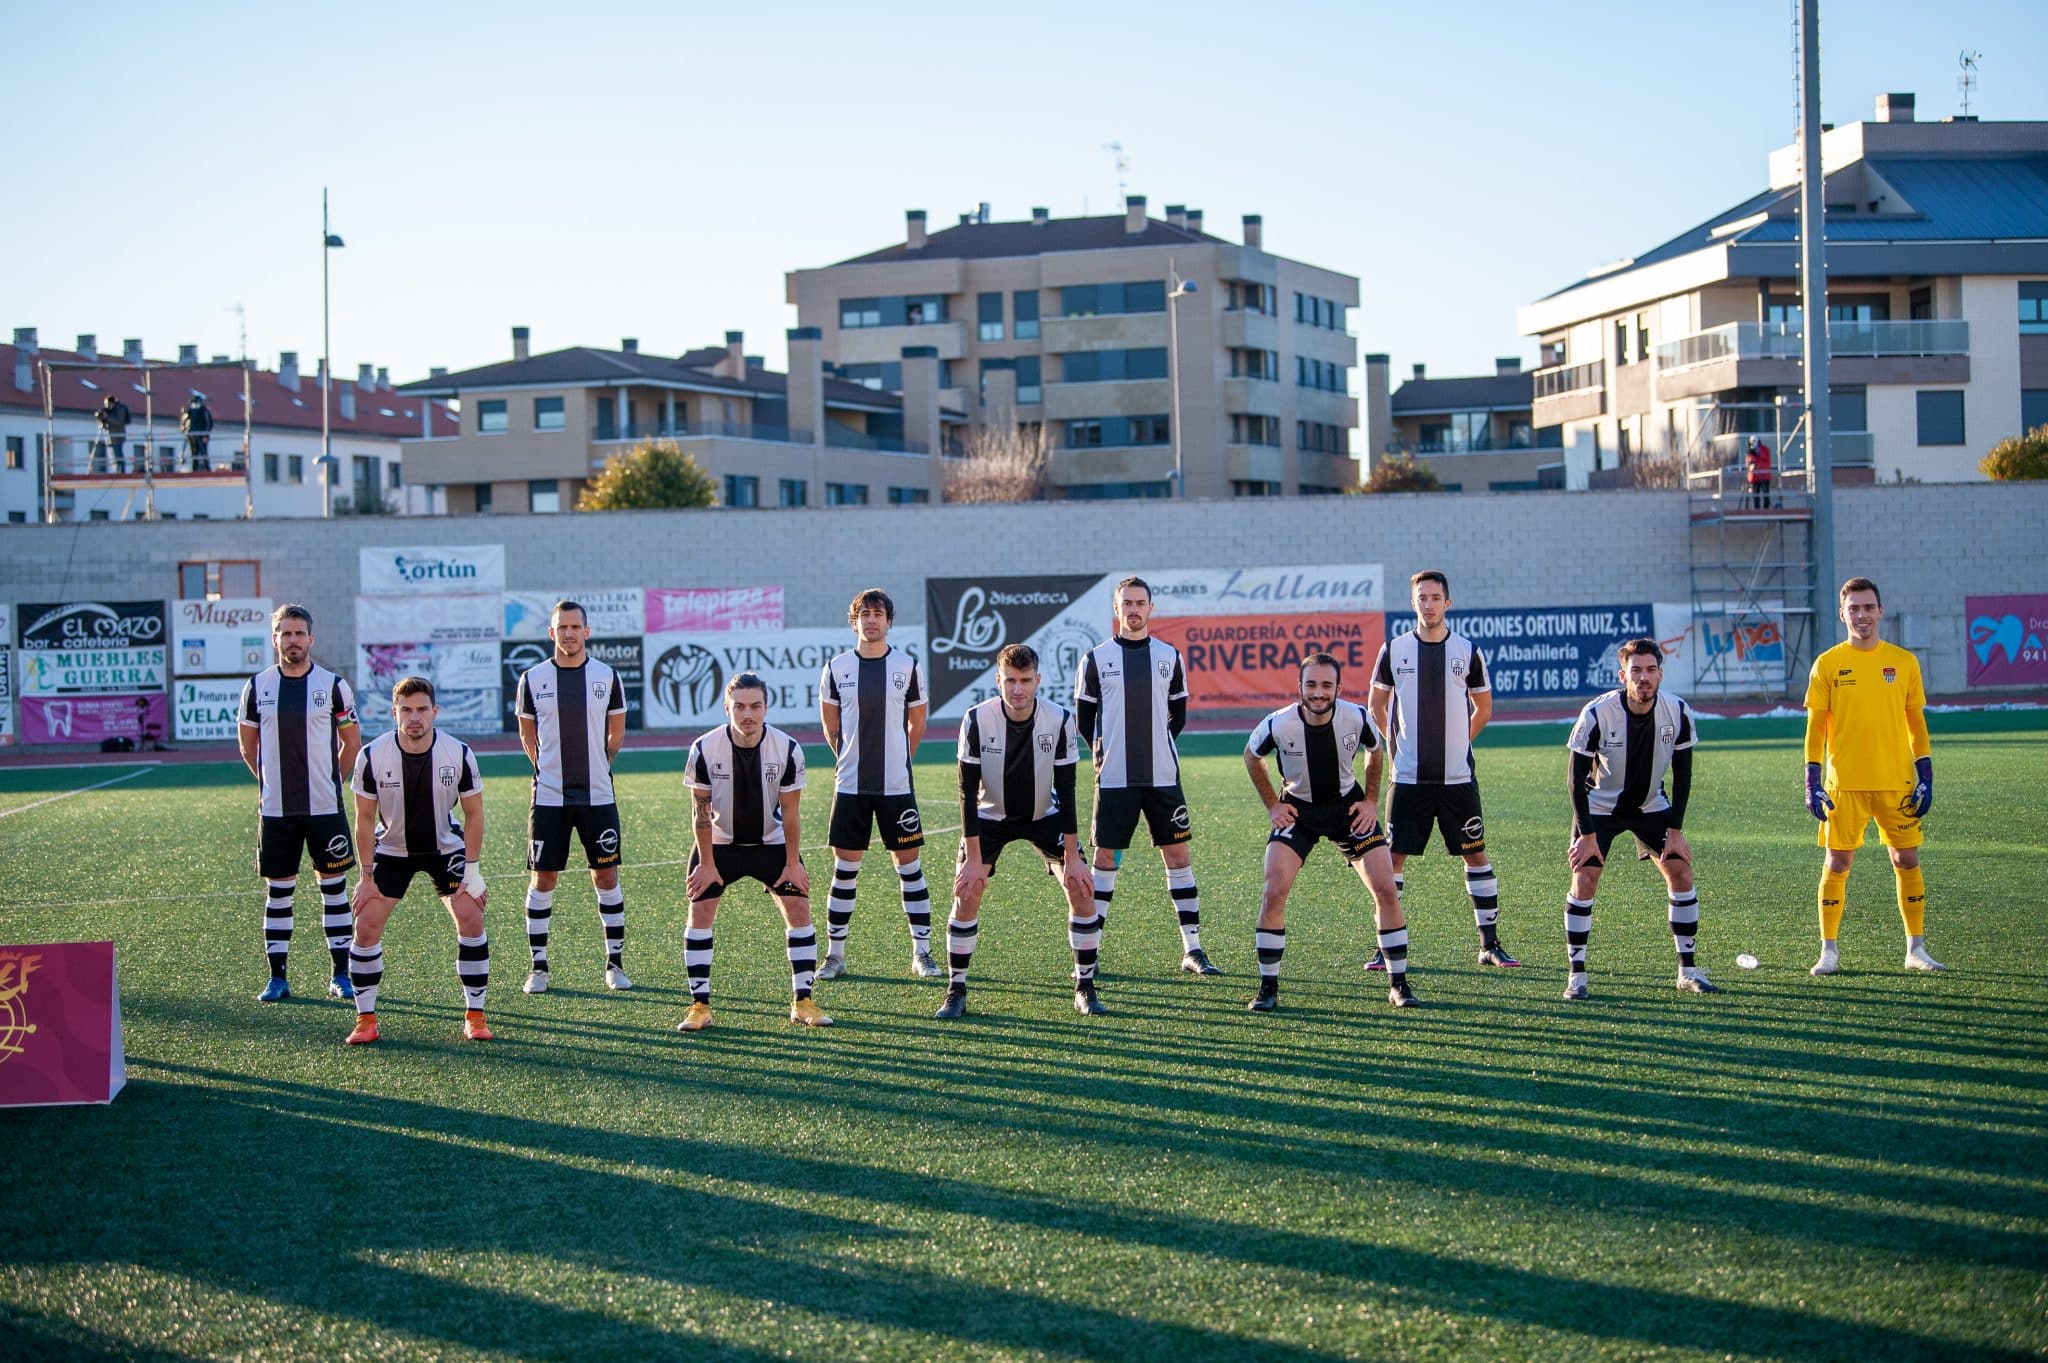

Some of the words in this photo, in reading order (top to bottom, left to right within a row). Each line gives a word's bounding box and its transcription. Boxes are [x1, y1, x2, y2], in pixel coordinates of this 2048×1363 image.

[1151, 585, 1208, 597] OCARES
[1217, 569, 1374, 602] Lallana
[183, 603, 264, 629] Muga
[1525, 614, 1577, 636] ORTUN
[1621, 612, 1648, 633] S.L.
[62, 618, 88, 637] EL
[1186, 621, 1287, 643] GUARDERÍA
[1293, 624, 1362, 640] CANINA
[24, 638, 50, 649] bar
[1497, 643, 1579, 662] Albañilería
[56, 650, 164, 667] MUEBLES
[2023, 650, 2047, 662] 941
[64, 668, 158, 685] GUERRA
[1495, 670, 1518, 691] 667
[1523, 669, 1539, 691] 51
[1543, 669, 1560, 690] 06
[1562, 668, 1580, 690] 89
